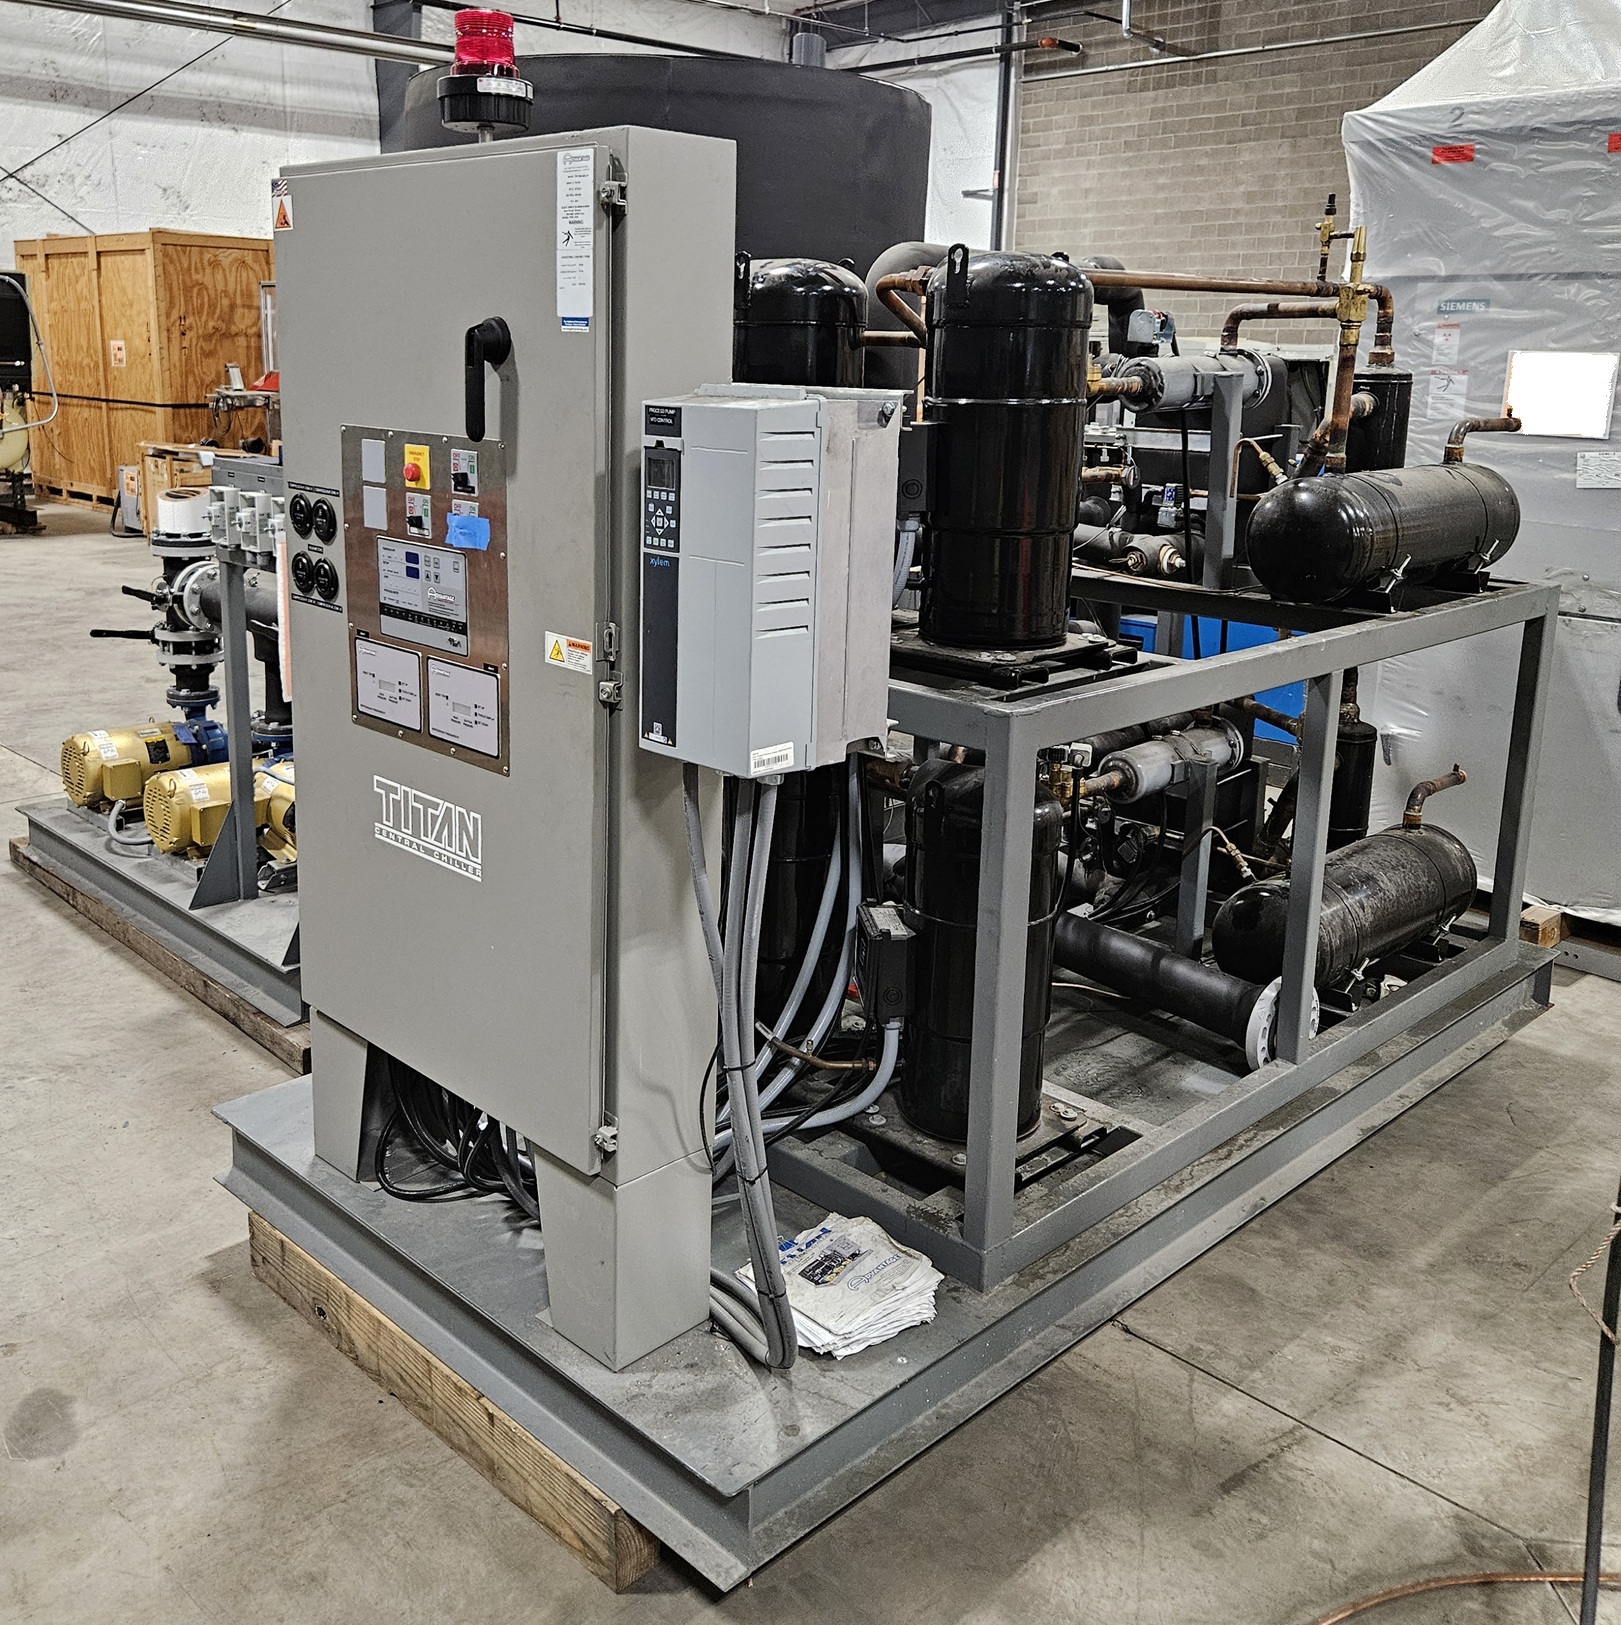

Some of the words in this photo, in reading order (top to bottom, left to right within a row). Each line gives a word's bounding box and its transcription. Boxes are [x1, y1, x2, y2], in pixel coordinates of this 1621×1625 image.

[1440, 301, 1486, 311] SIEMENS
[649, 556, 670, 568] xylem
[373, 774, 482, 865] TITAN
[374, 826, 425, 853] CENTRAL
[433, 851, 482, 878] CHILLER
[847, 1253, 902, 1291] ADVANTAGE
